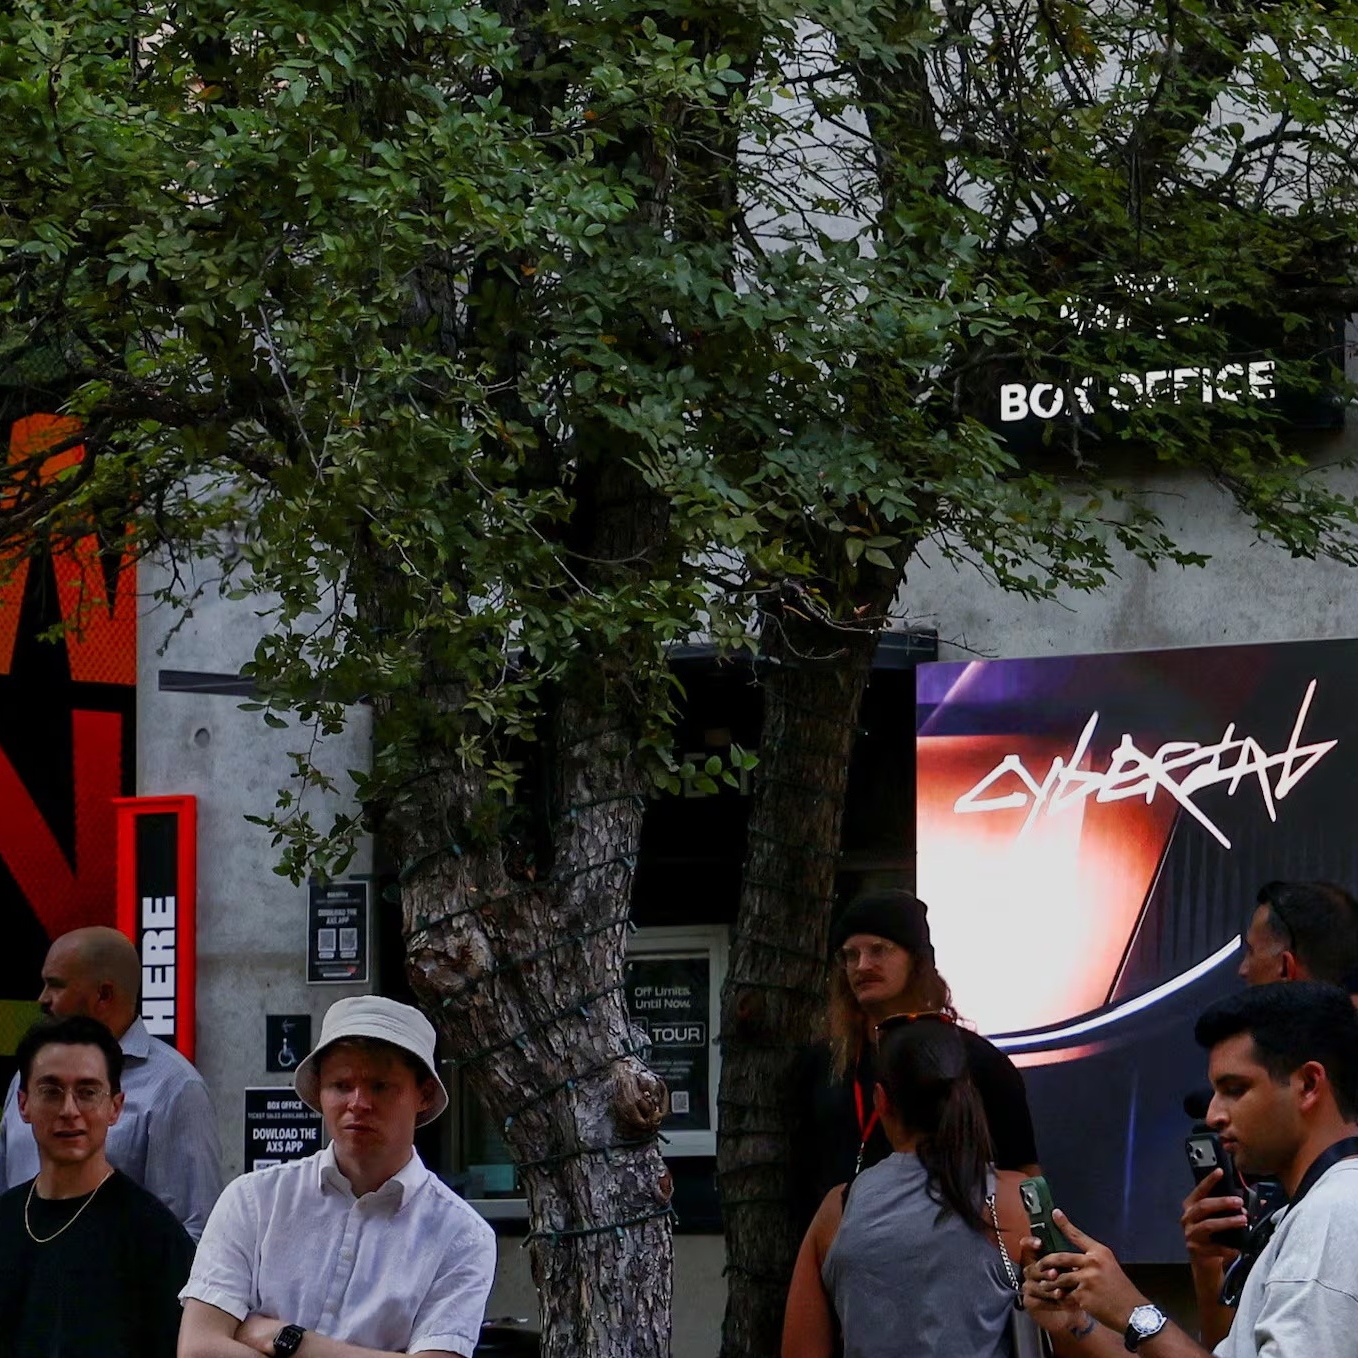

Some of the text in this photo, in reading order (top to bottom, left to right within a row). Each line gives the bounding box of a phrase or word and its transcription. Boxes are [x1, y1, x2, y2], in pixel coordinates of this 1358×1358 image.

[635, 999, 661, 1009] Until
[652, 1028, 701, 1042] TOUR
[267, 1100, 303, 1110] BOX OFFICE
[299, 1128, 317, 1139] THE
[266, 1141, 304, 1152] AXS APP
